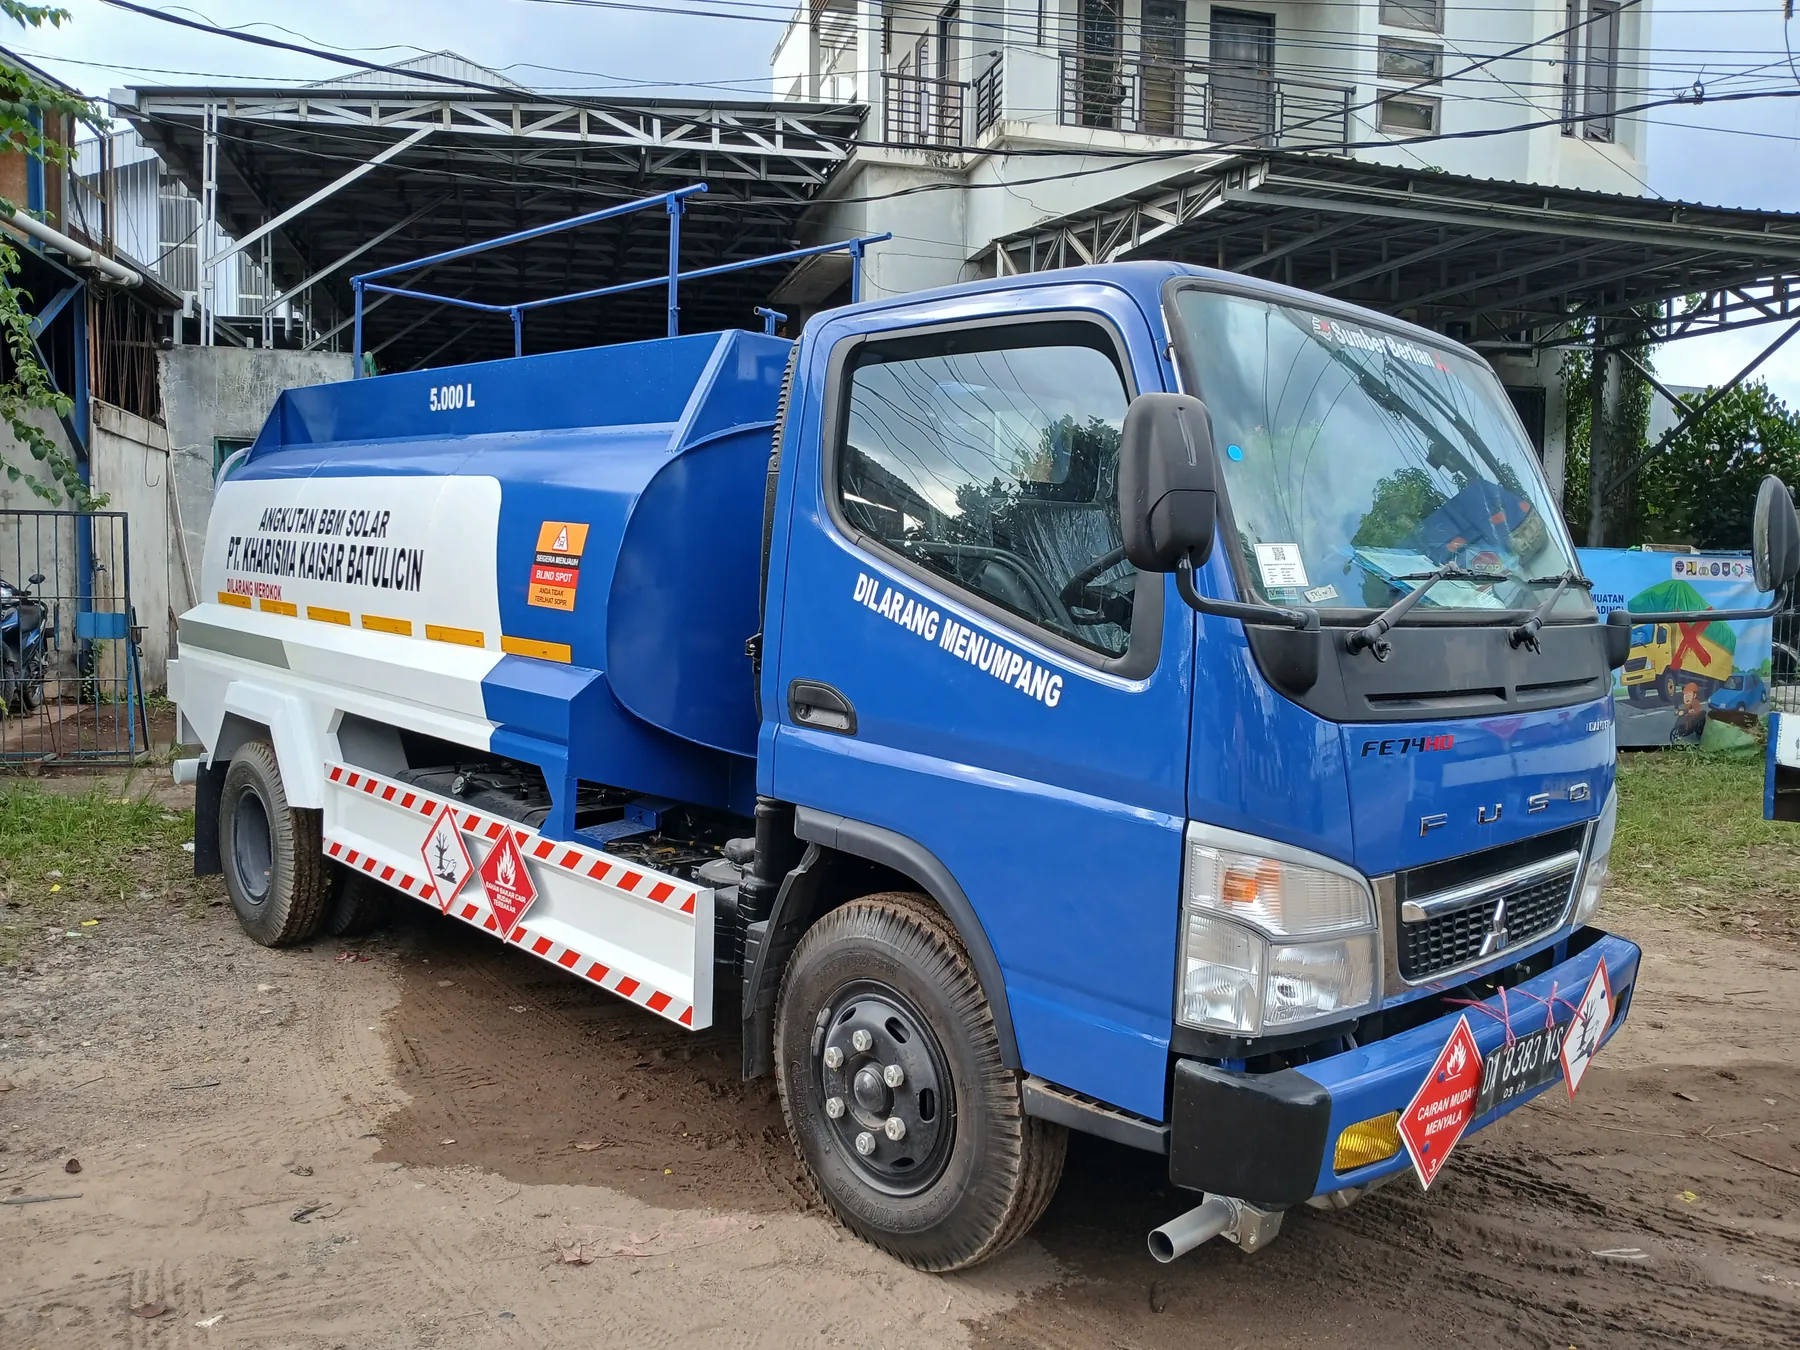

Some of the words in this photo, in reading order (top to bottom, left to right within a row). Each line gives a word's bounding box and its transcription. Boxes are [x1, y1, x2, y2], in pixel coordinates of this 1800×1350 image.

[1330, 321, 1387, 355] Sumber
[1385, 335, 1436, 368] Berlian
[430, 384, 464, 411] 5.000
[467, 383, 475, 407] L
[258, 507, 319, 534] ANGKUTAN
[317, 509, 347, 536] BBM
[345, 509, 391, 538] SOLAR
[226, 536, 242, 571] PT.
[242, 537, 297, 578] KHARISMA
[298, 541, 345, 582] KAISAR
[346, 545, 424, 592] BATULICIN
[536, 554, 555, 563] SEGERA
[226, 578, 254, 597] DILARANG
[254, 582, 283, 601] MEROKOK
[536, 569, 554, 581] BLIND
[555, 572, 572, 583] SPOT
[853, 572, 940, 641] DILARANG
[938, 618, 1063, 708] MENUMPANG
[1361, 734, 1455, 758] FE74HD
[1419, 782, 1588, 837] FUSO
[1502, 1034, 1542, 1082] 8383
[1542, 1026, 1564, 1065] NS
[1417, 1096, 1449, 1121] CAIRAN
[1449, 1085, 1477, 1108] MUDAH
[1424, 1109, 1462, 1137] MENYALA
[1429, 1158, 1437, 1173] 3
